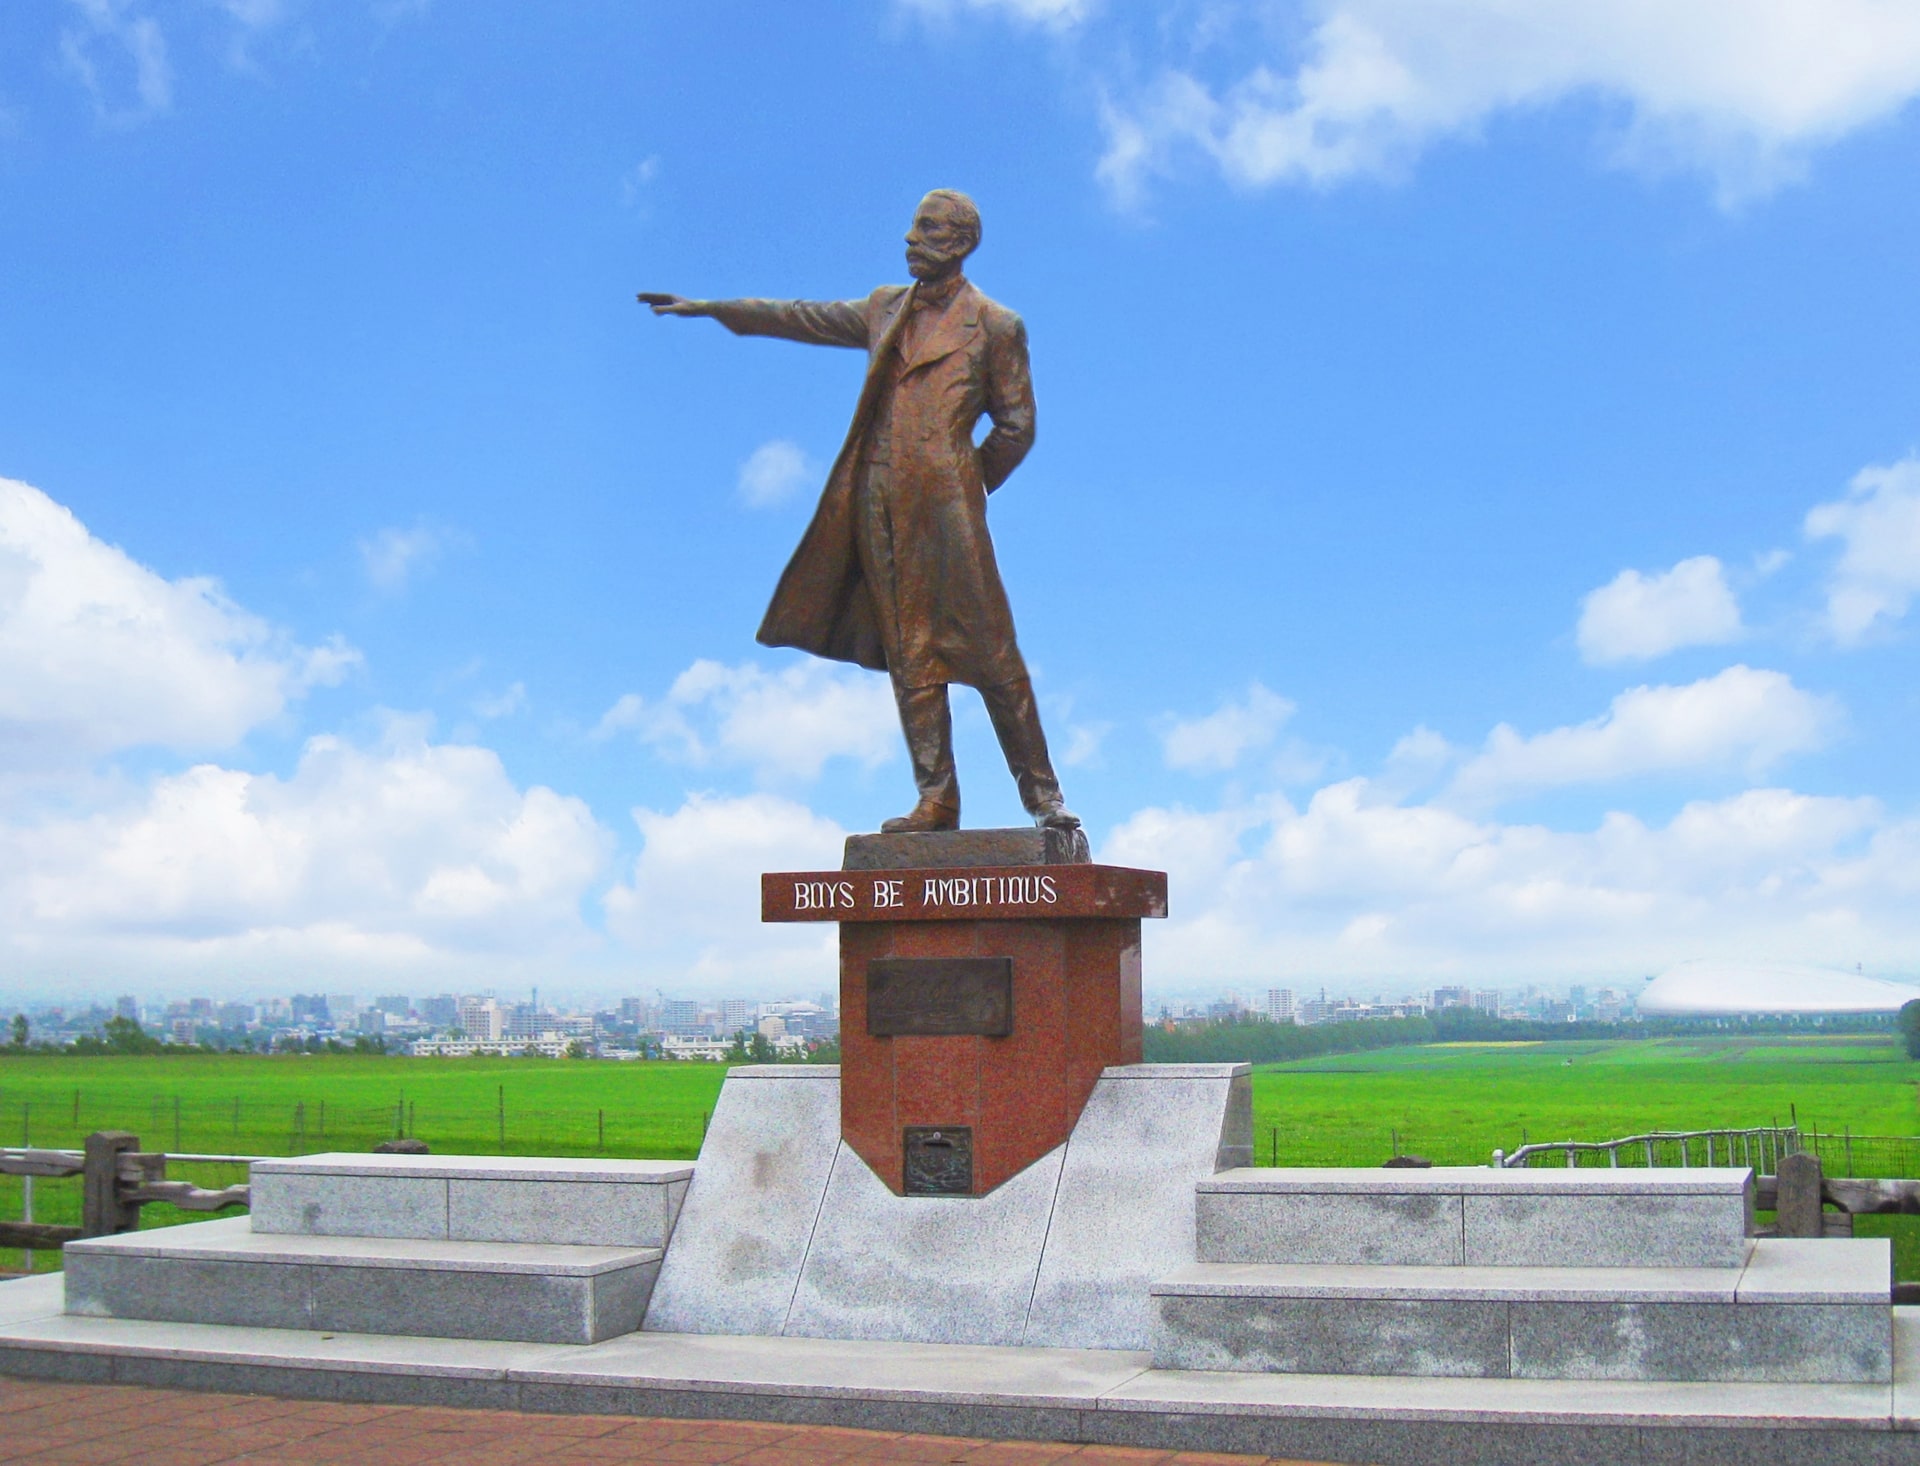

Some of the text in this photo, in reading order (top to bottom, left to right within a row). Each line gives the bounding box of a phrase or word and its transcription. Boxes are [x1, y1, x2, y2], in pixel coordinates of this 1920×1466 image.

[794, 875, 1057, 910] BOYS BE AMBITIOUS
